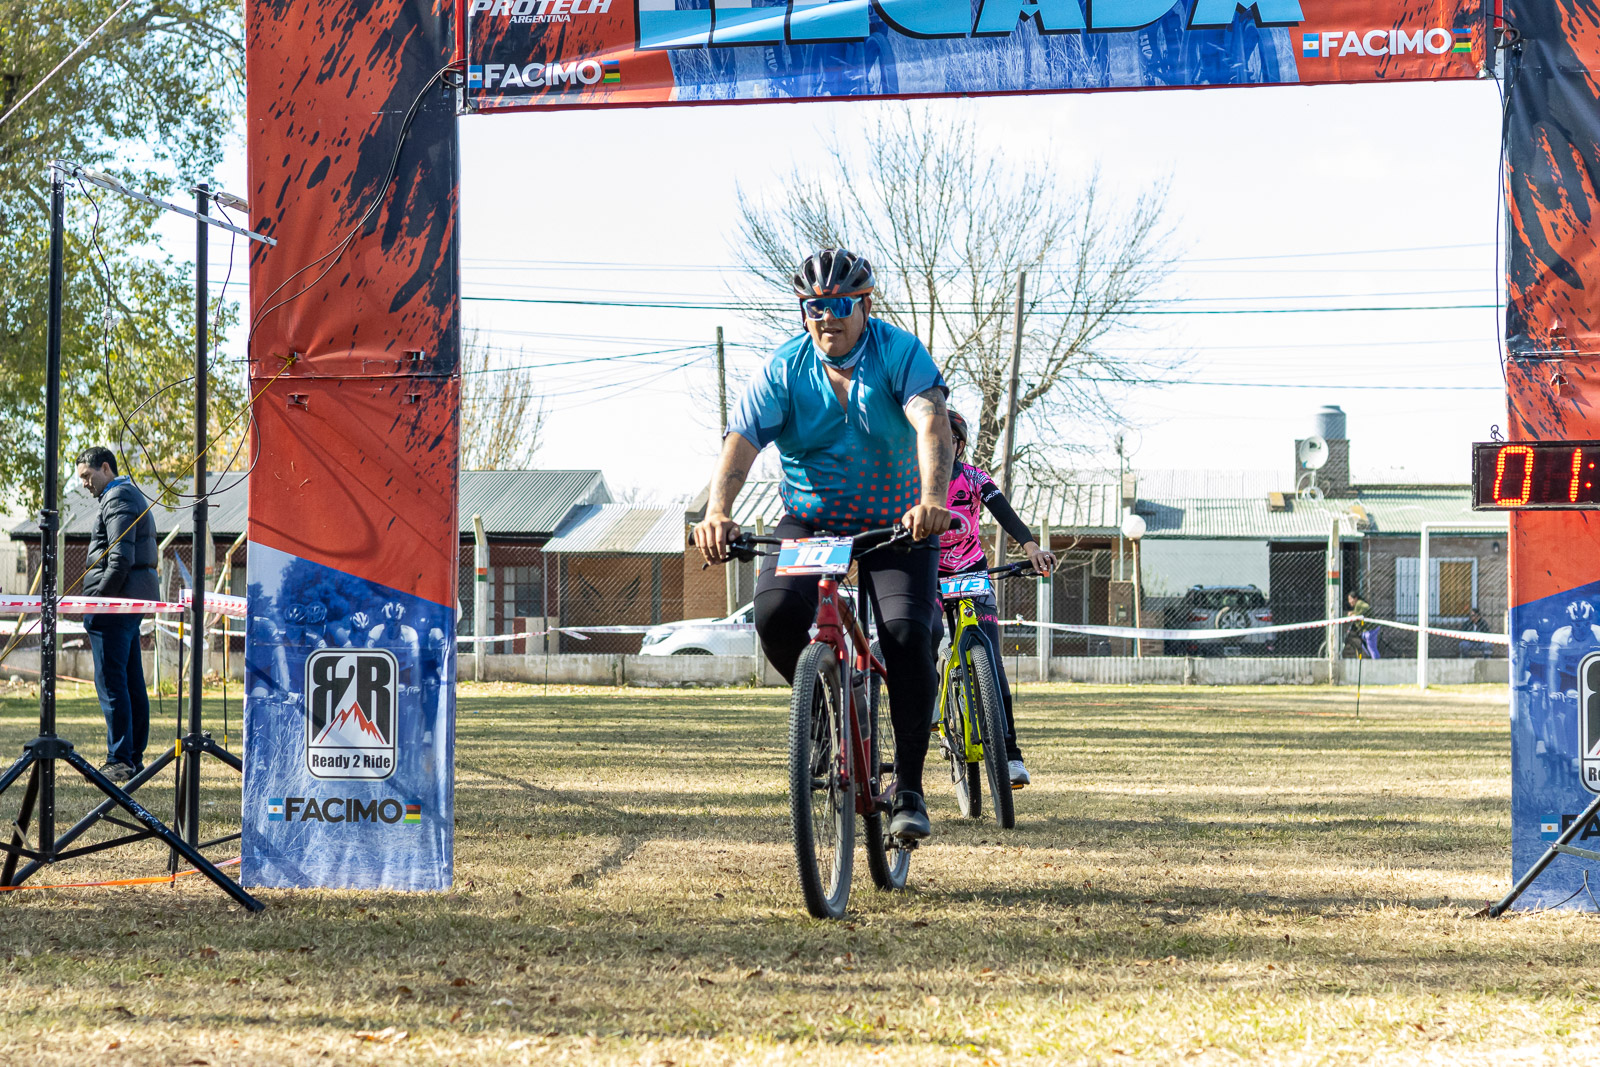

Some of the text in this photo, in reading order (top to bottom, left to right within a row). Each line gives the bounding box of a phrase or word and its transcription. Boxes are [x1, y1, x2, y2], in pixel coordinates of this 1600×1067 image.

[468, 0, 613, 17] PROTECH
[508, 14, 571, 24] ARGENTINA
[1321, 27, 1452, 57] FACIMO
[484, 60, 602, 88] FACIMO
[947, 578, 986, 593] 173
[312, 754, 391, 769] Ready 2 Ride
[285, 797, 403, 824] FACIMO
